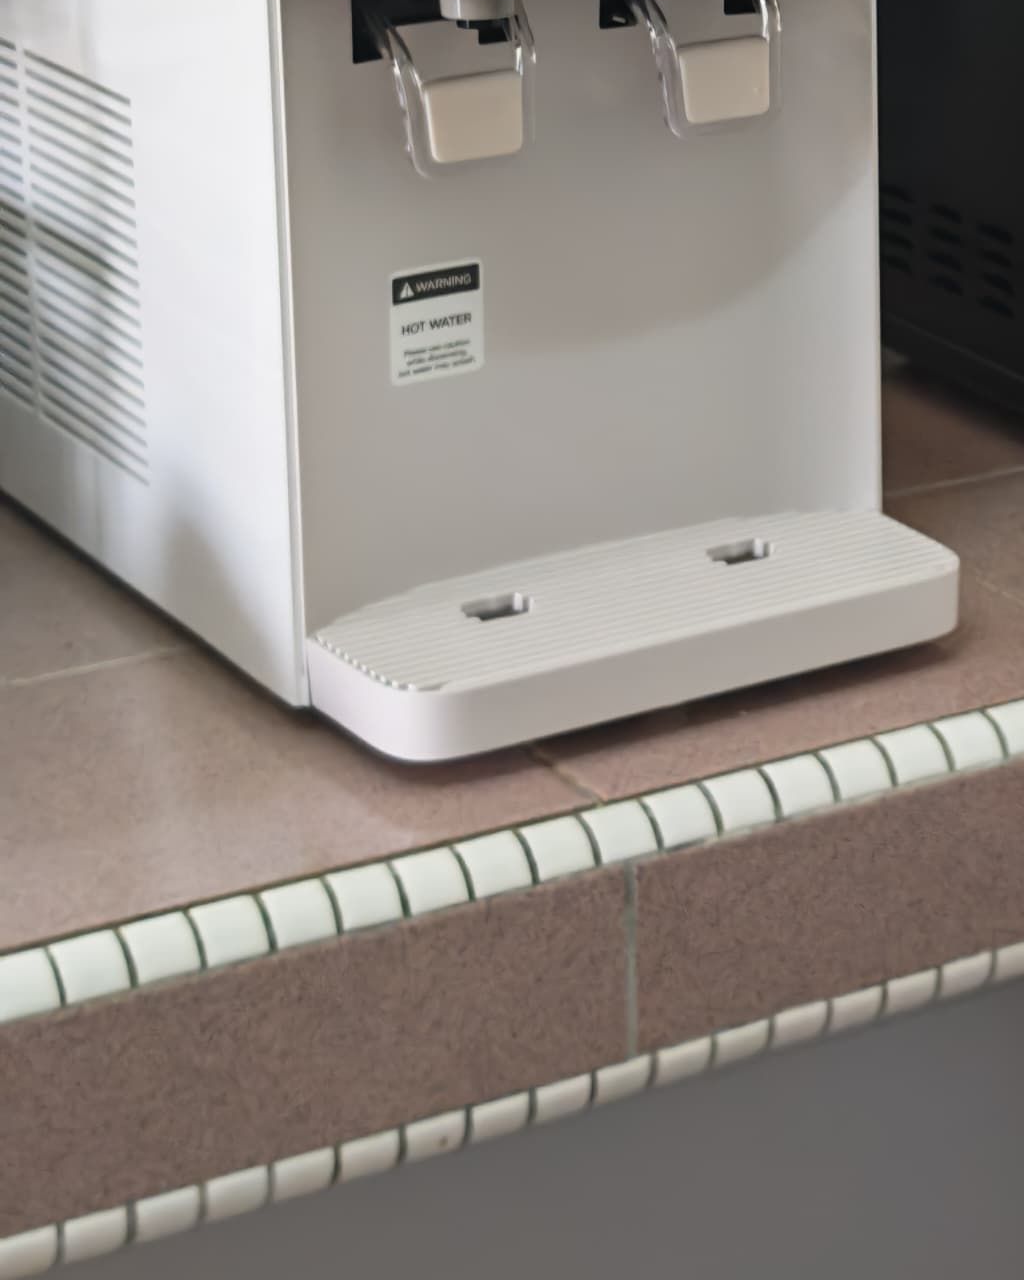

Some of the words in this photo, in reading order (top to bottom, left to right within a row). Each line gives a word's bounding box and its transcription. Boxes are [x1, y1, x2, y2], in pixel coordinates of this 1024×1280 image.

[415, 274, 471, 292] WARNING
[401, 320, 426, 336] HOT
[428, 312, 472, 331] WATER
